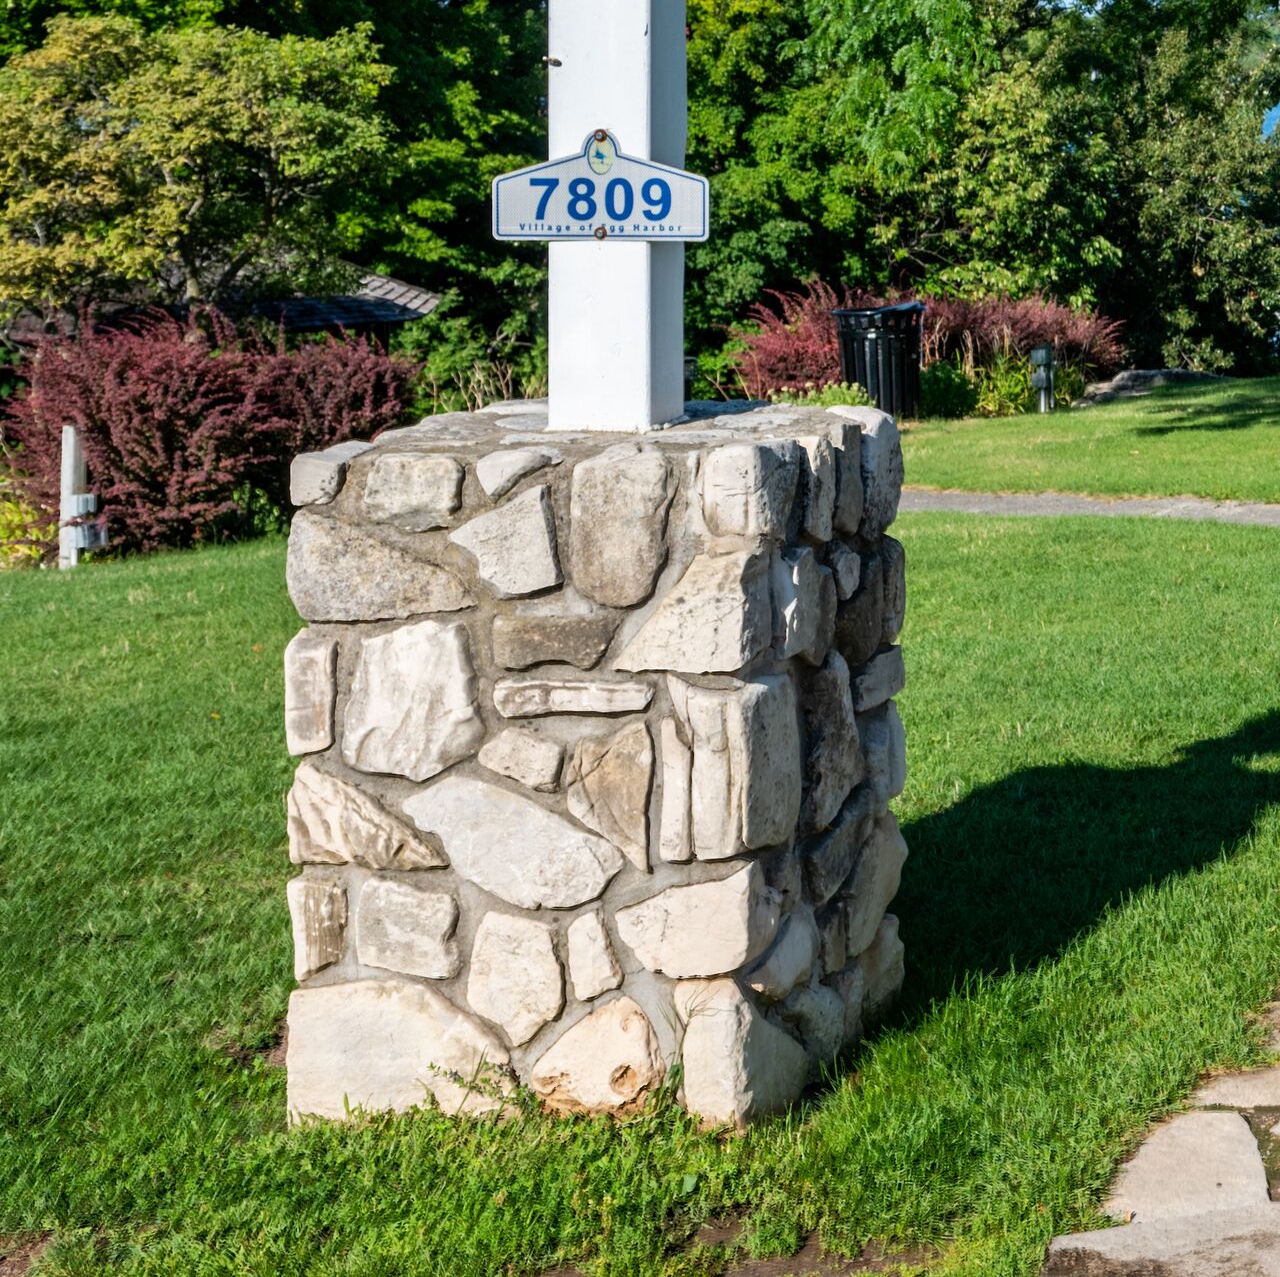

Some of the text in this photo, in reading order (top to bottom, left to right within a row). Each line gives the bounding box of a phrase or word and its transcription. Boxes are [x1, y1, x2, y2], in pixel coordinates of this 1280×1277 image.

[529, 177, 672, 221] 7809
[519, 223, 570, 232] Village
[579, 223, 592, 231] of
[633, 223, 682, 232] Harbor
